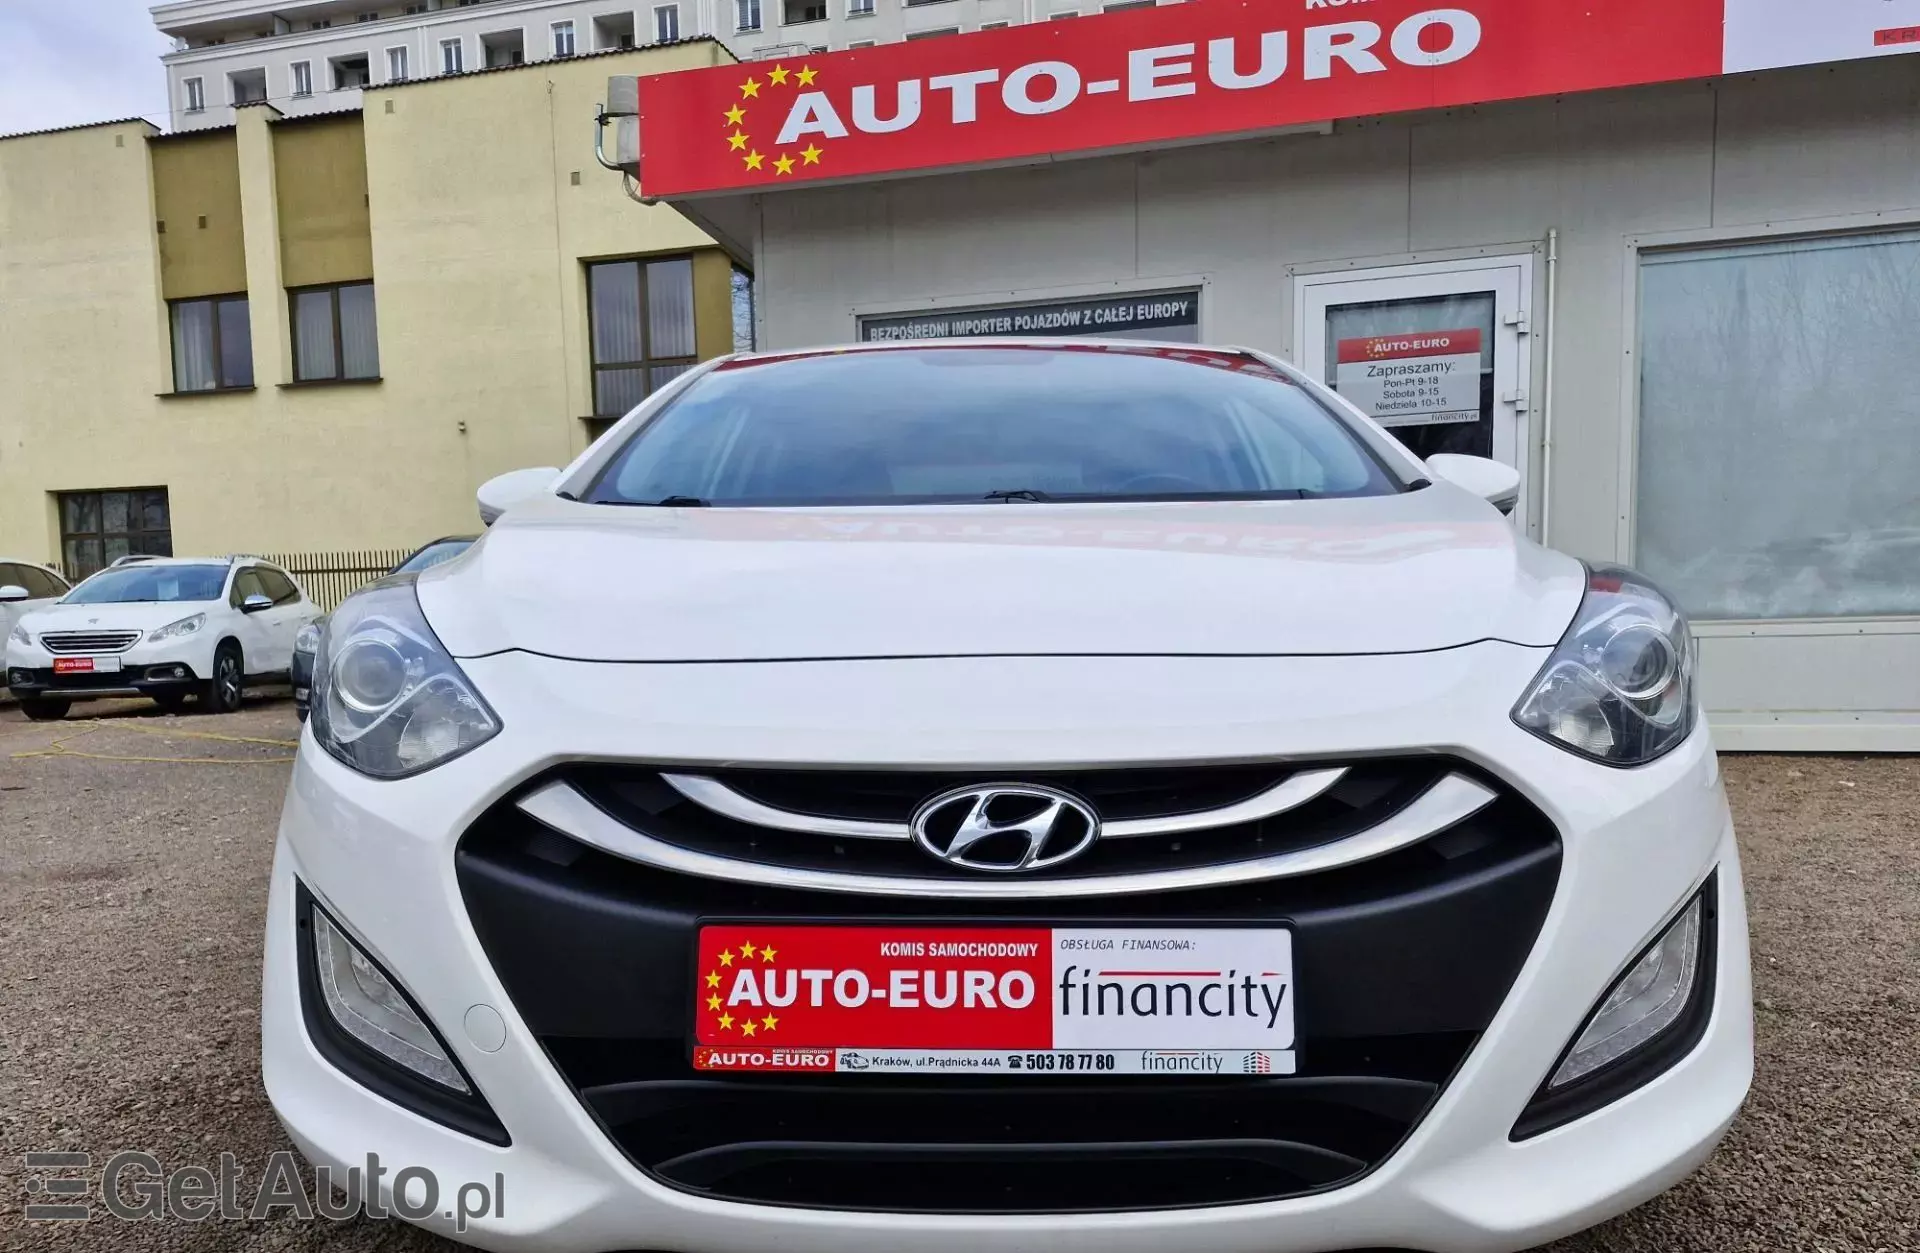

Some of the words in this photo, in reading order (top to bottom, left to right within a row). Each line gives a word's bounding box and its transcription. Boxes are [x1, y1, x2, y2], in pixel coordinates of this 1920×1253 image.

[774, 8, 1482, 145] AUTO-EURO
[870, 320, 949, 341] BEZPOŚREDNI
[951, 316, 1012, 336] IMPORTER
[1014, 311, 1081, 331] POJAZDÓW
[1083, 309, 1092, 325] Z
[1095, 305, 1134, 323] CAŁEJ
[1137, 301, 1188, 320] EUROPY
[1373, 337, 1450, 353] AUTO-EURO
[1367, 361, 1456, 378] Zapraszamy:
[1383, 378, 1415, 388] Pon-Pt
[1417, 376, 1439, 386] 9-18
[1383, 389, 1416, 399] Sobota
[1418, 388, 1439, 397] 9-15
[1375, 400, 1417, 411] Niedziela
[1421, 399, 1447, 408] 10-15
[880, 942, 925, 957] KOMIS
[928, 942, 1038, 957] SAMOCHODOWY
[1060, 939, 1114, 950] OBSŁUGA
[1121, 939, 1196, 950] FINANSOWA:
[727, 968, 1035, 1009] AUTO-EURO
[1058, 965, 1287, 1029] financity
[708, 1052, 830, 1067] AUTO-EURO
[872, 1056, 913, 1067] Kraków,
[981, 1058, 1001, 1067] 44A
[1026, 1054, 1055, 1070] 503
[1058, 1054, 1075, 1070] 78
[1078, 1054, 1093, 1070] 77
[1096, 1054, 1115, 1070] 80
[1141, 1050, 1223, 1074] financity
